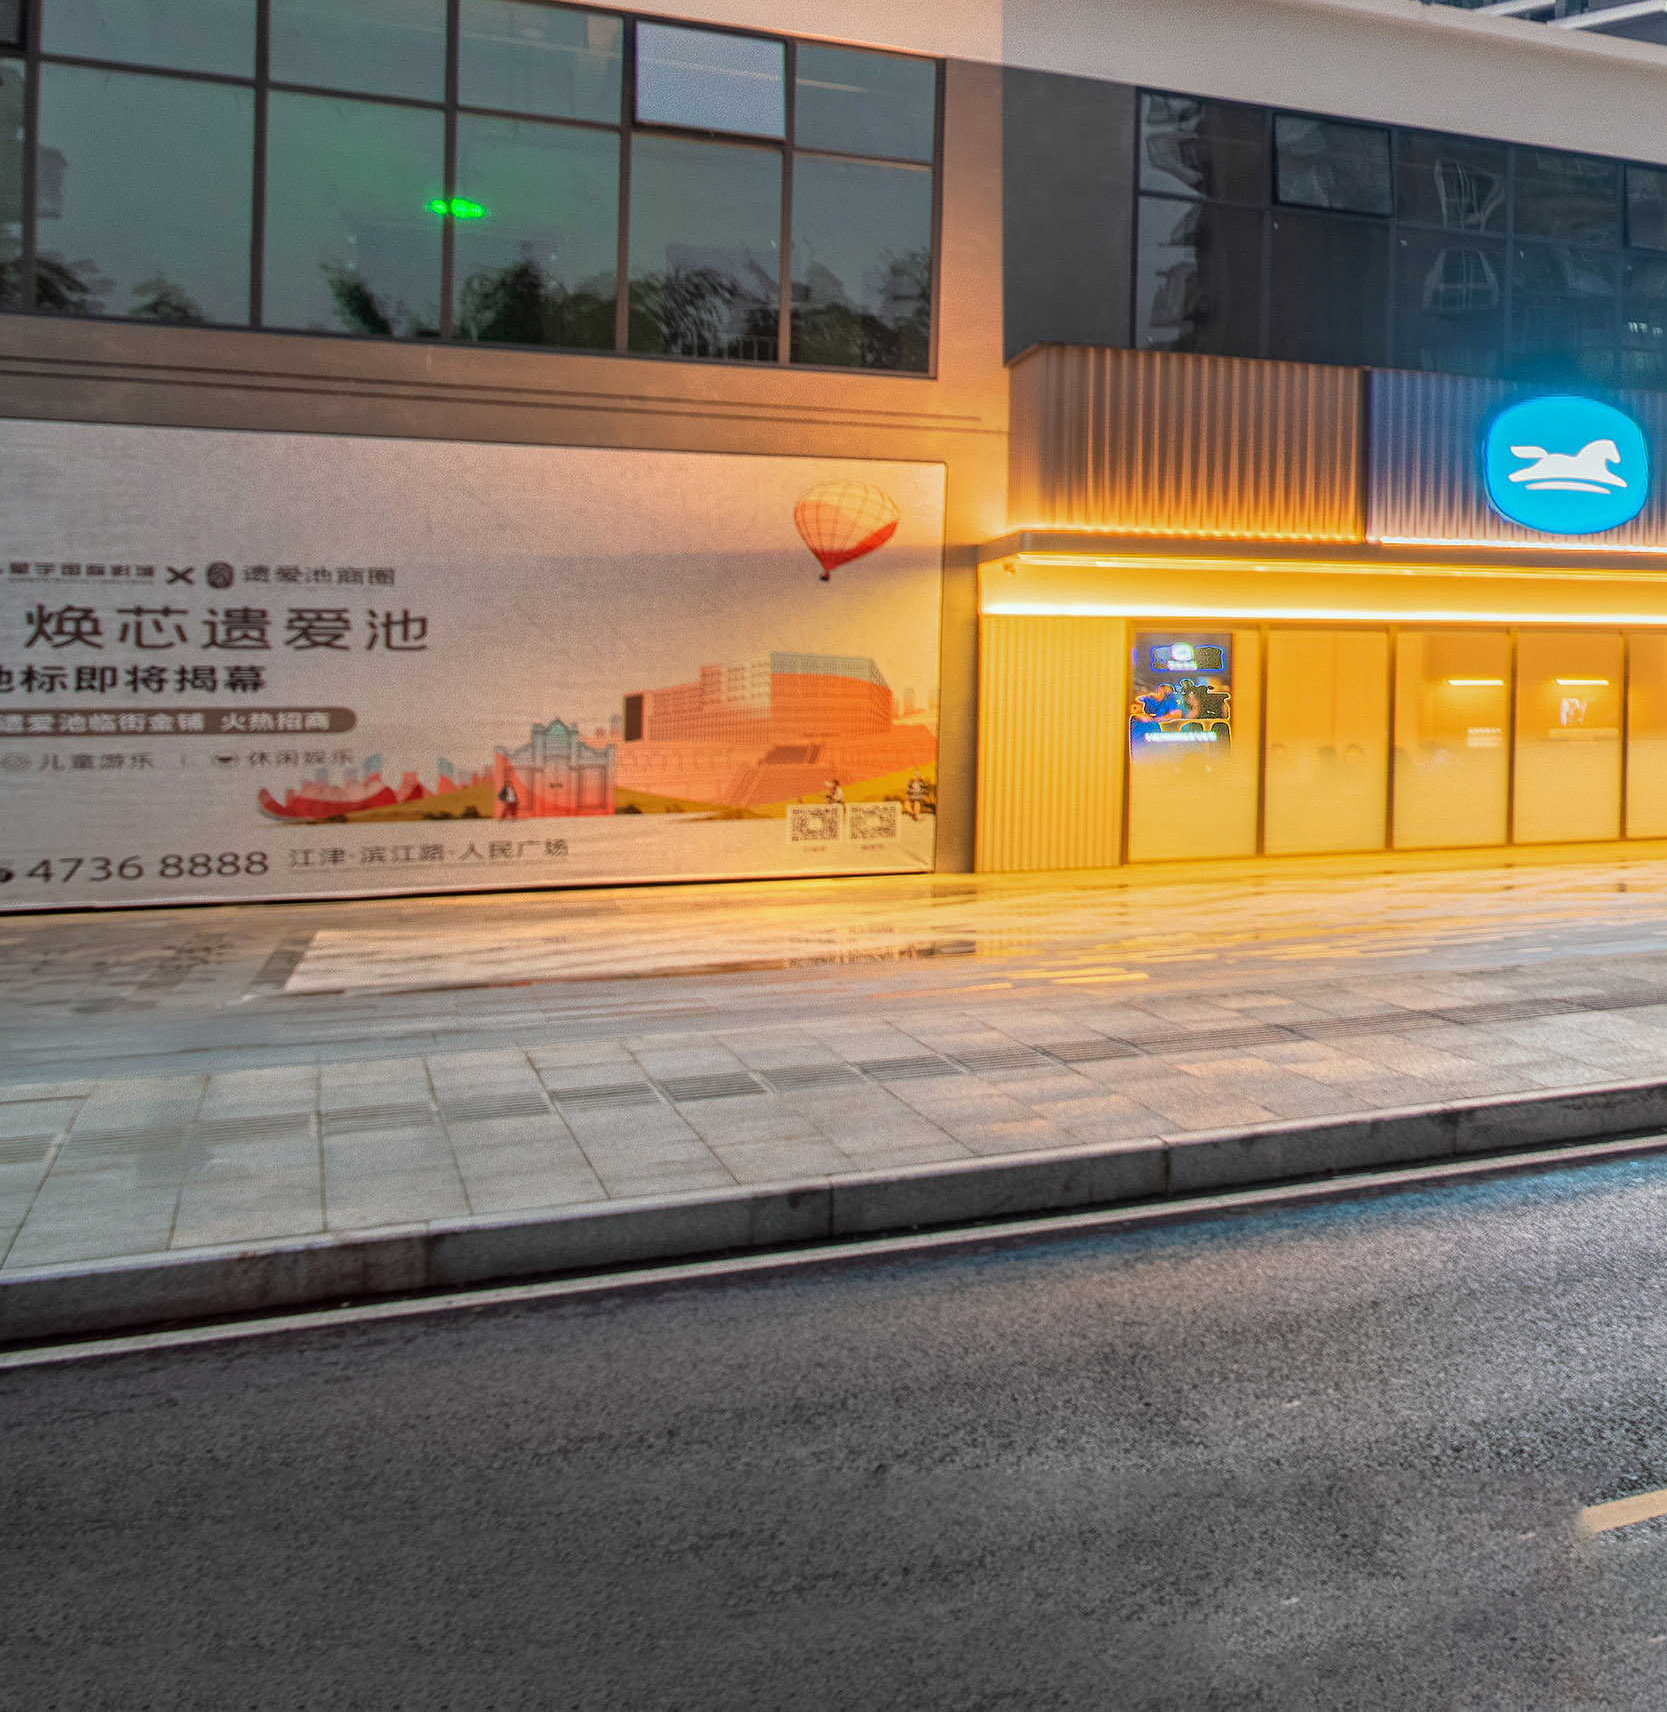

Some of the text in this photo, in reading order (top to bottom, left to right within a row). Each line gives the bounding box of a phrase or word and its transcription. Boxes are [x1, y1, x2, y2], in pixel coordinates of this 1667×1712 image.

[25, 603, 429, 651] 焕芯遗爱池
[220, 712, 331, 732] 火热招商
[39, 748, 355, 771] 儿童游乐 休闲娱乐
[25, 855, 144, 883] 4736
[159, 851, 270, 877] 8888
